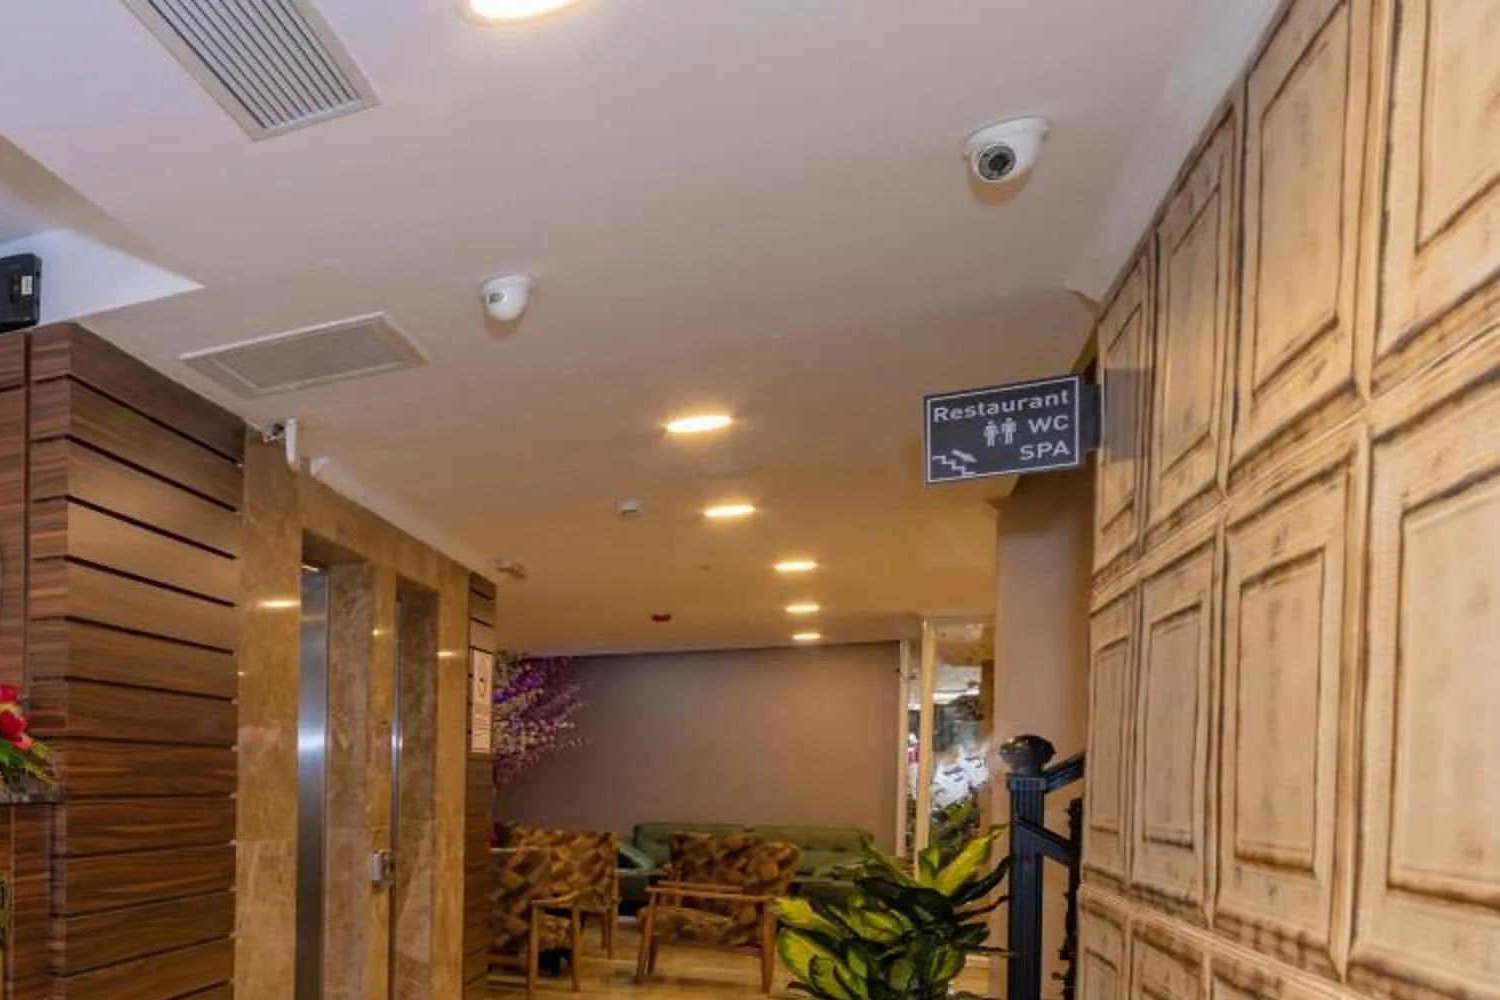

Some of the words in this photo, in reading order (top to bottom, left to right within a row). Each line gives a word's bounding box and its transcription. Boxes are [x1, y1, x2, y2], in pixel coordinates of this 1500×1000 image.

[932, 389, 1070, 424] Restaurant
[1027, 414, 1070, 434] WC
[1018, 440, 1071, 462] SPA
